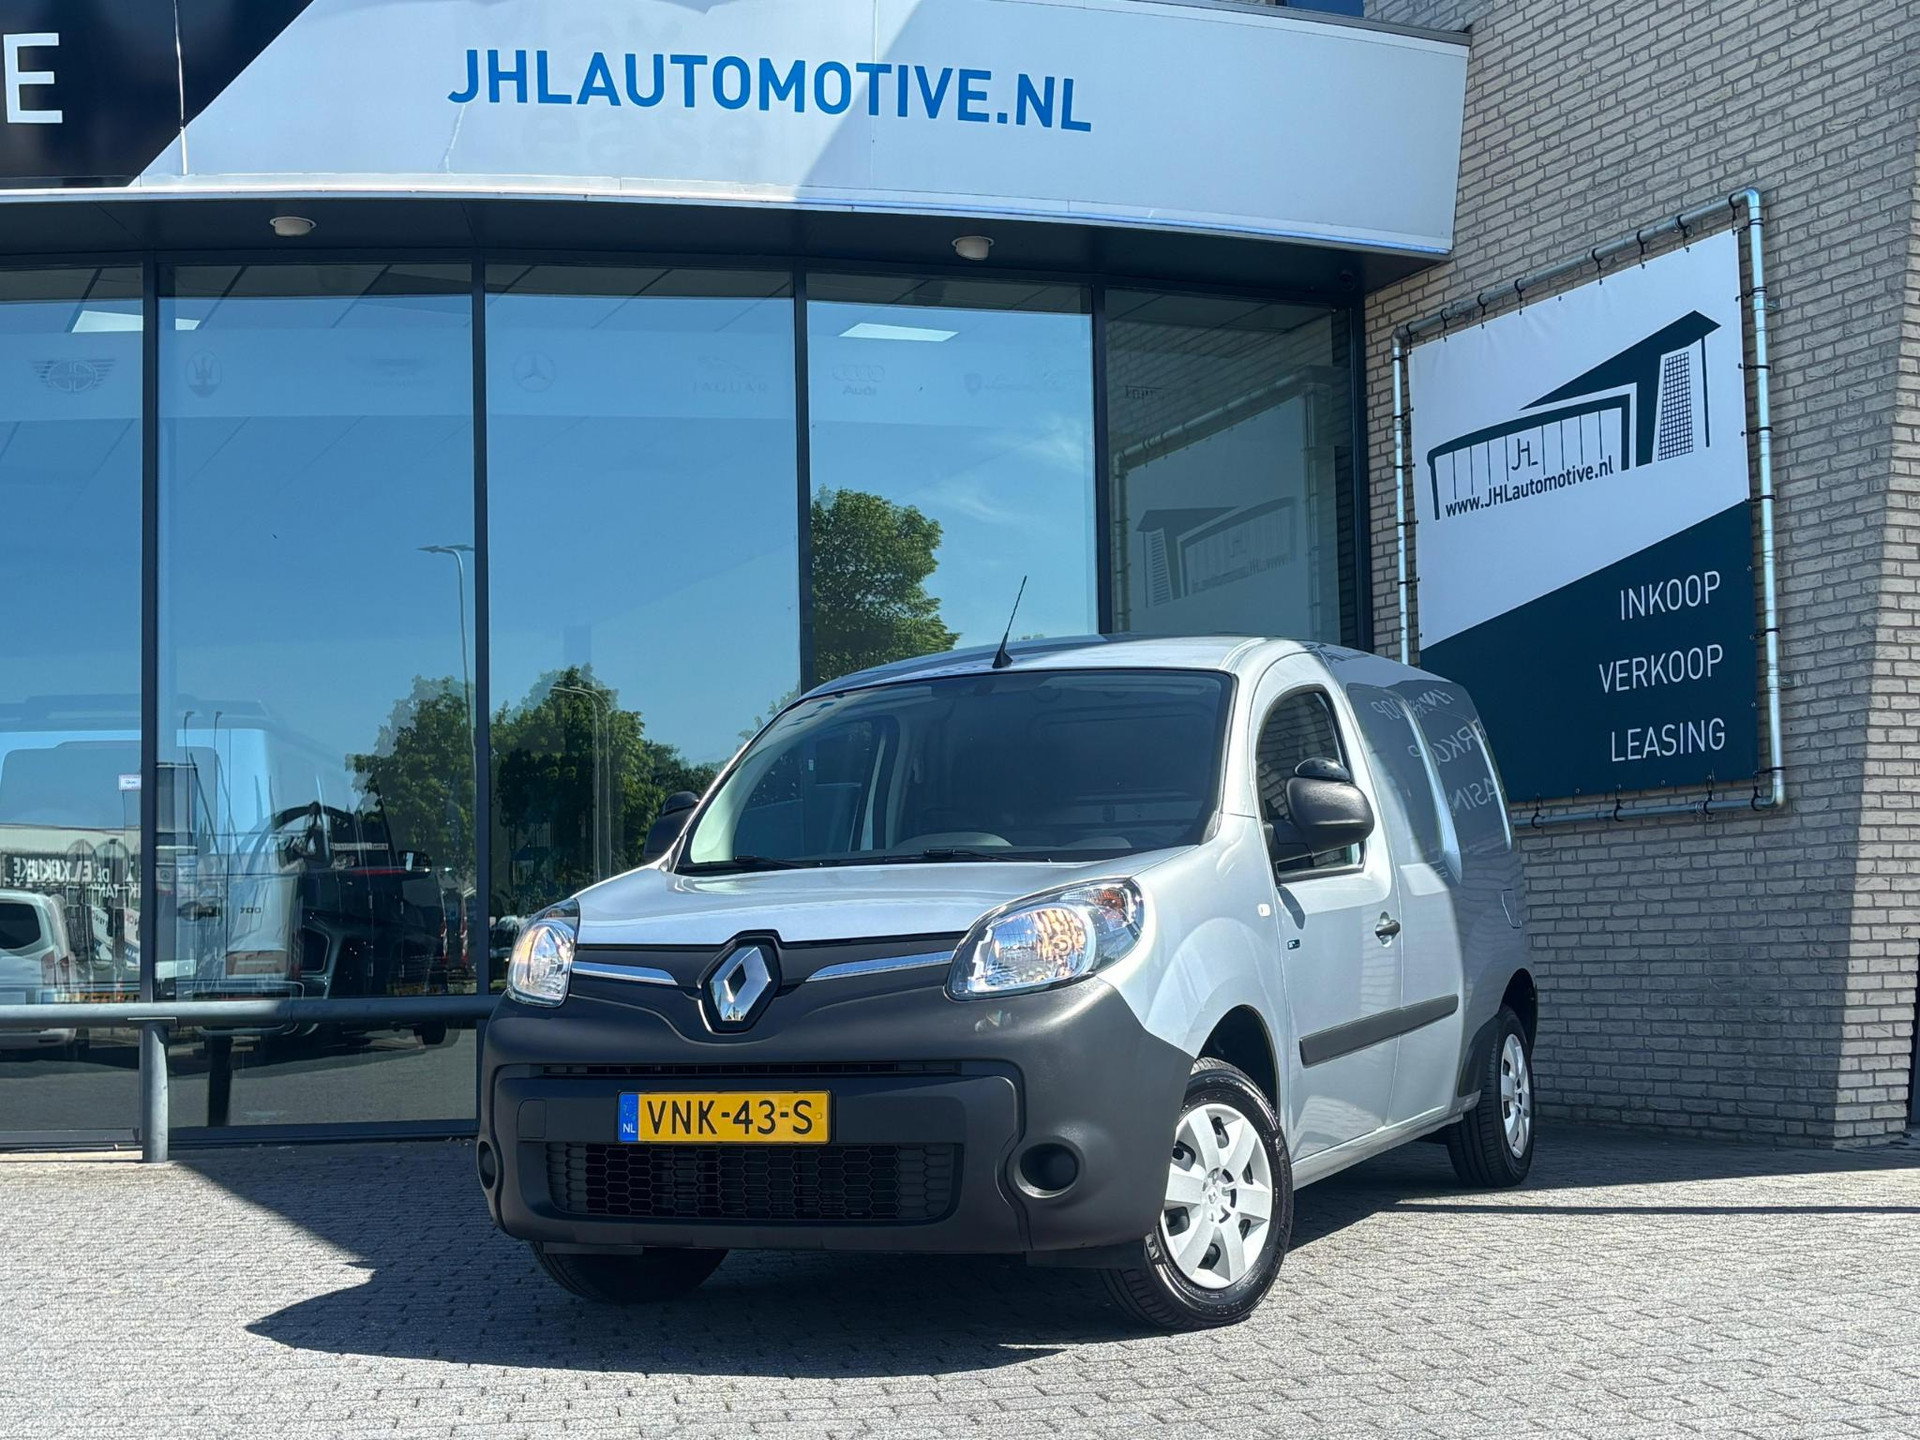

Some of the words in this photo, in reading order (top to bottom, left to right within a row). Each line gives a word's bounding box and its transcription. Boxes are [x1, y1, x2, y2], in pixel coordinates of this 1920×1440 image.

[3, 33, 63, 123] E
[447, 49, 1092, 132] JHLAUTOMOTIVE.NL
[1445, 455, 1614, 518] www.JHLautomotive.nl
[1620, 570, 1721, 621] INKOOP
[1599, 644, 1723, 693] VERKOOP
[1611, 717, 1726, 762] LEASING
[622, 1123, 637, 1134] NL
[647, 1100, 813, 1135] VNK-43-S
